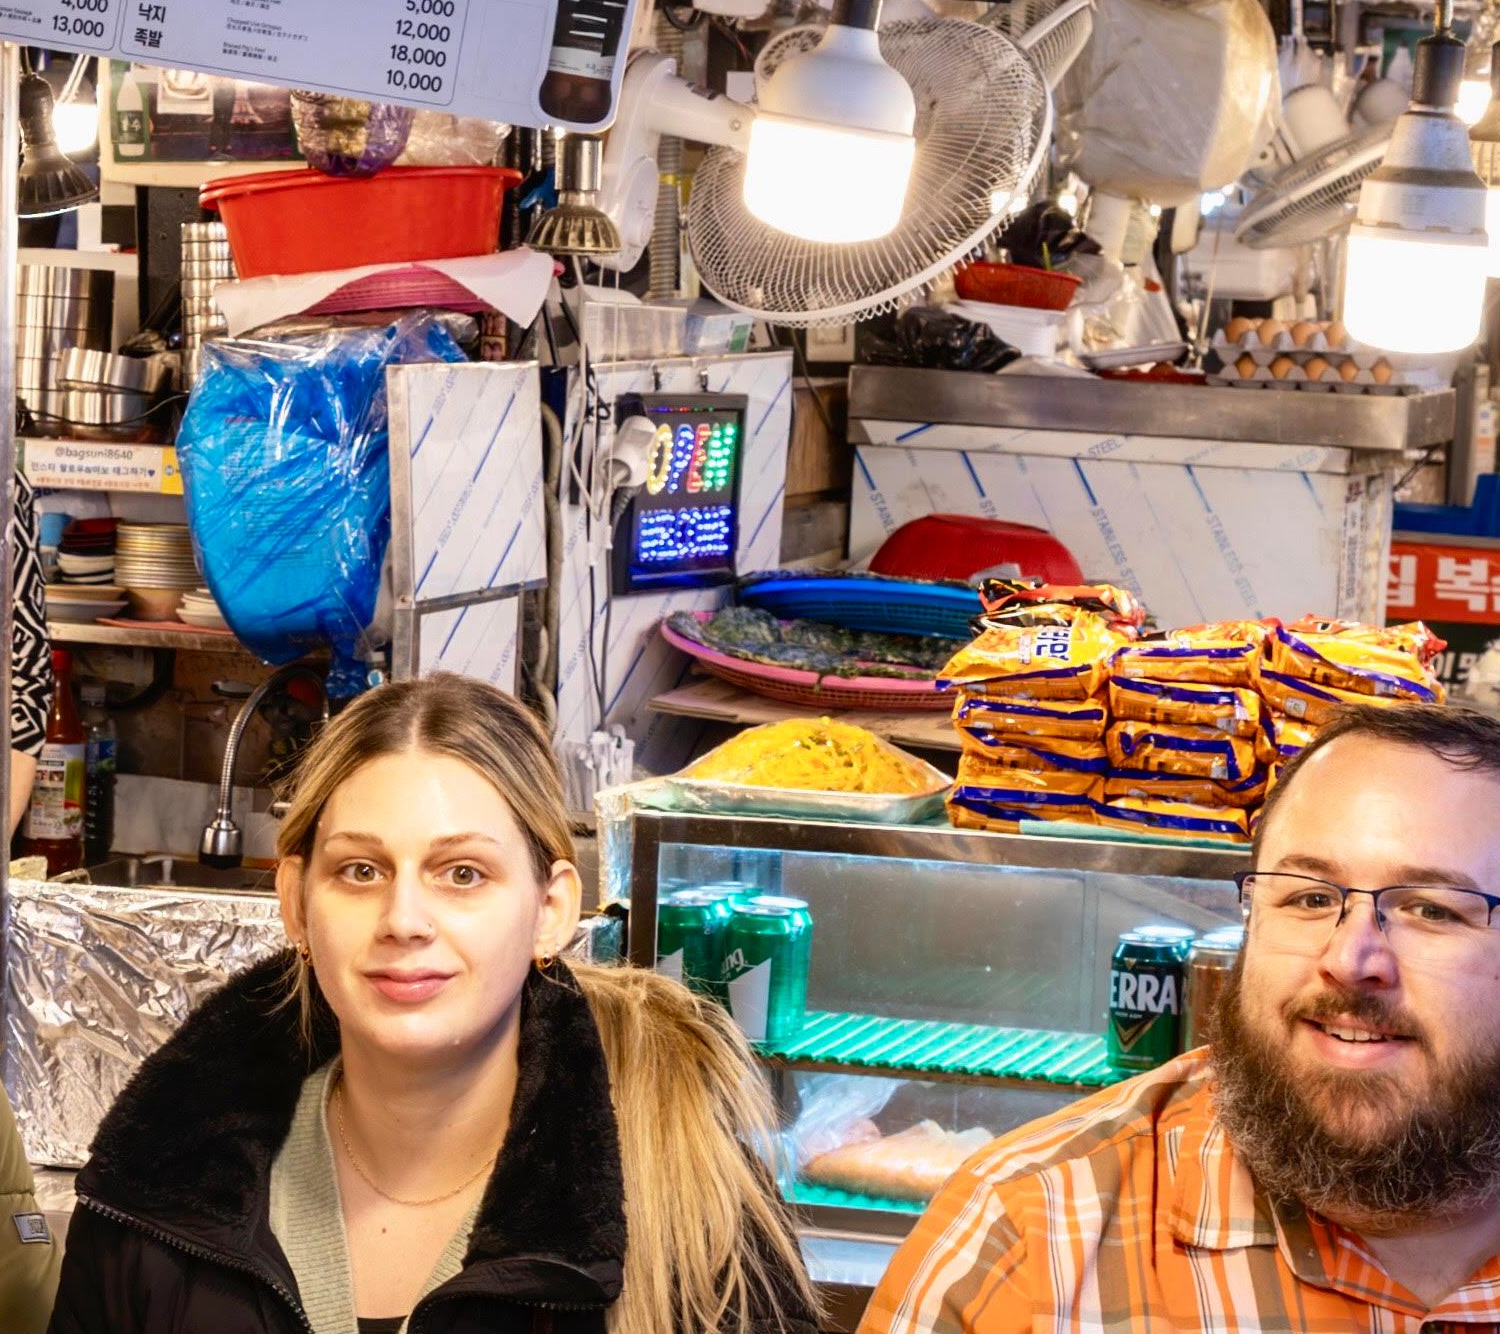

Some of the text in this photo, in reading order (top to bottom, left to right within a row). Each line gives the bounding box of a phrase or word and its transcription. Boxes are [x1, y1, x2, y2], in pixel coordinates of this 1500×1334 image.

[138, 3, 166, 24] 낙지
[52, 15, 105, 38] 13,000
[134, 27, 164, 48] 족발
[395, 19, 450, 42] 12,000
[390, 44, 446, 67] 18,000
[386, 69, 442, 92] 10,000
[647, 423, 738, 496] OPEN
